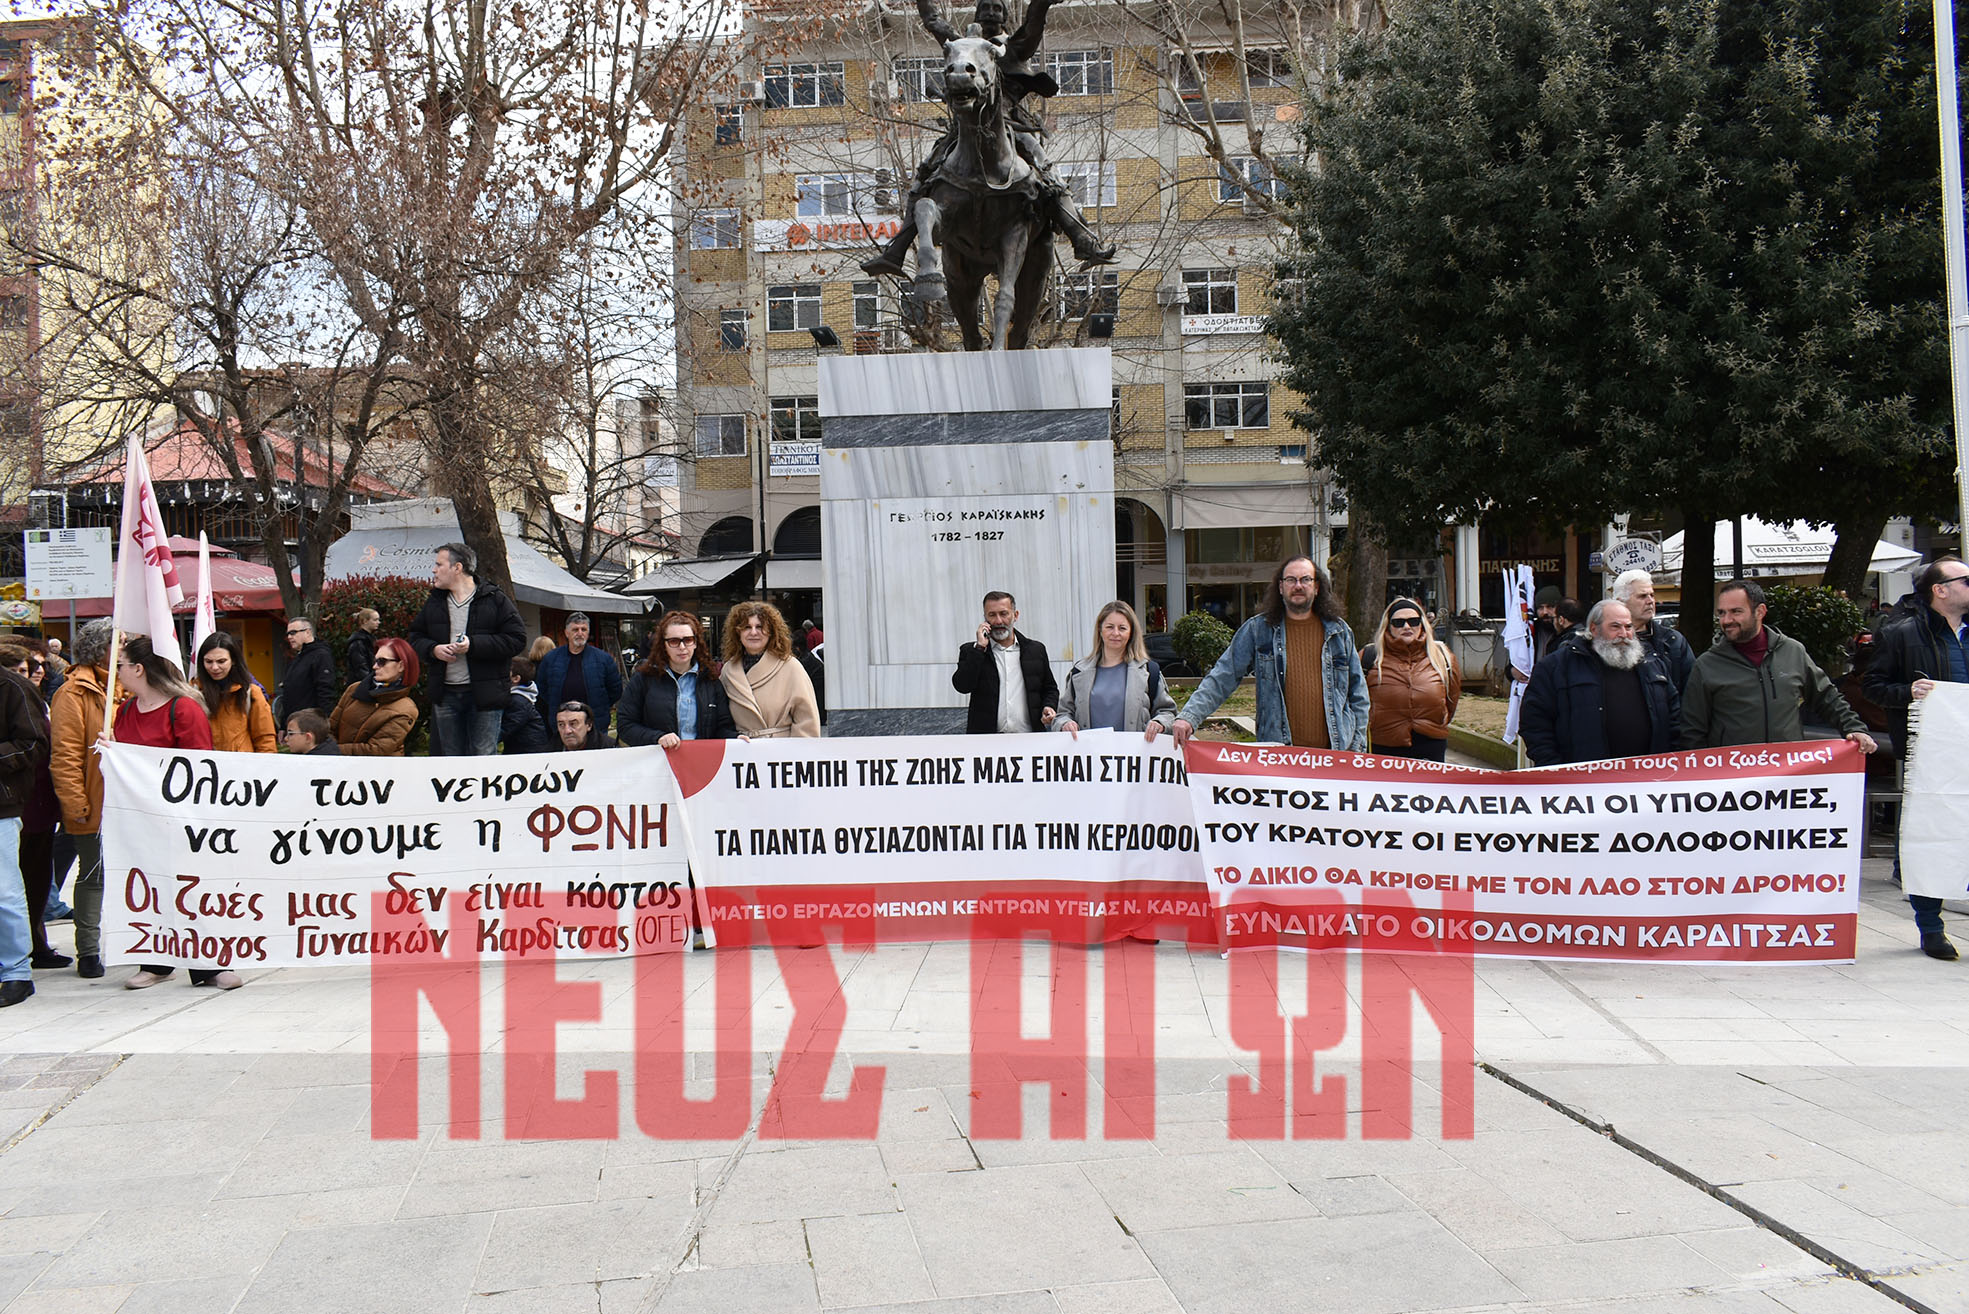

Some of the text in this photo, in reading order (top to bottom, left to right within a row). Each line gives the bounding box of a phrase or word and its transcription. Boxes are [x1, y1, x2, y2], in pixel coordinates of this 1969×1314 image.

[380, 544, 437, 557] Cosmi
[931, 532, 961, 542] 1782
[974, 531, 1004, 541] 1827
[1608, 541, 1637, 562] ΣΤΑΘΜΟΣ
[1754, 545, 1830, 554] KARATZOGLOU
[732, 761, 760, 789] ΤΑ
[767, 760, 848, 789] ΤΕΜΠΗ
[856, 758, 899, 786] ΤΗΣ
[906, 757, 965, 785] ΖΩΗΣ
[973, 756, 1024, 784] ΜΑΣ
[1032, 755, 1092, 783] ΕΙΝΑΙ
[1100, 755, 1141, 783] ΣΤΗ
[1216, 747, 1253, 764] Δεν
[1257, 748, 1333, 769] ξεχνάμε
[1353, 753, 1375, 769] δε
[1632, 756, 1679, 773] τους
[1685, 751, 1698, 768] ή
[1703, 752, 1724, 768] οι
[1729, 747, 1780, 770] ζωές
[1787, 746, 1833, 766] μας!
[311, 778, 394, 806] των
[431, 763, 584, 802] νεκρών
[1213, 786, 1837, 815] ΚΟΣΤΟΣ Η ΑΣΦΑΛΕΙΑ ΚΑΙ ΟΙ ΥΠΟΔΟΜΕΣ,
[185, 803, 667, 865] να γίνουμε η ΦΩΝΗ
[715, 829, 742, 857] ΤΑ
[750, 828, 827, 856] ΠΑΝΤΑ
[834, 824, 984, 854] ΘΥΣΙΑΖΟΝΤΑΙ
[992, 823, 1027, 850] ΓΙΑ
[1034, 822, 1080, 850] ΤΗΝ
[1205, 822, 1849, 853] ΤΟΥ ΚΡΑΤΟΥΣ ΟΙ ΕΥΘΥΝΕΣ ΔΟΛΟΦΟΝΙΚΕΣ
[1213, 866, 1846, 896] ΤΟ ΔΙΚΙΟ ΘΑ ΚΡΙΘΕΙ ΜΕ ΤΟΝ ΛΑΟ ΣΤΟΝ ΔΡΟΜΟ!
[125, 867, 682, 926] Οι ζωές μας δεν είναι κόστος
[793, 900, 947, 920] ΕΡΓΑΖΟΜΕΝΩΝ
[952, 899, 1050, 916] ΚΕΝΤΡΩΝ
[1055, 899, 1121, 917] ΥΓΕΙΑΣ
[1124, 899, 1142, 915] Ν.
[124, 912, 690, 967] Σύλλογος Γυναικών Καρδίτσας (ΟΓΕ)
[1226, 911, 1836, 949] ΣΥΝΔΙΚΑΤΟ ΟΙΚΟΔΟΜΩΝ ΚΑΡΔΙΤΣΑΣ
